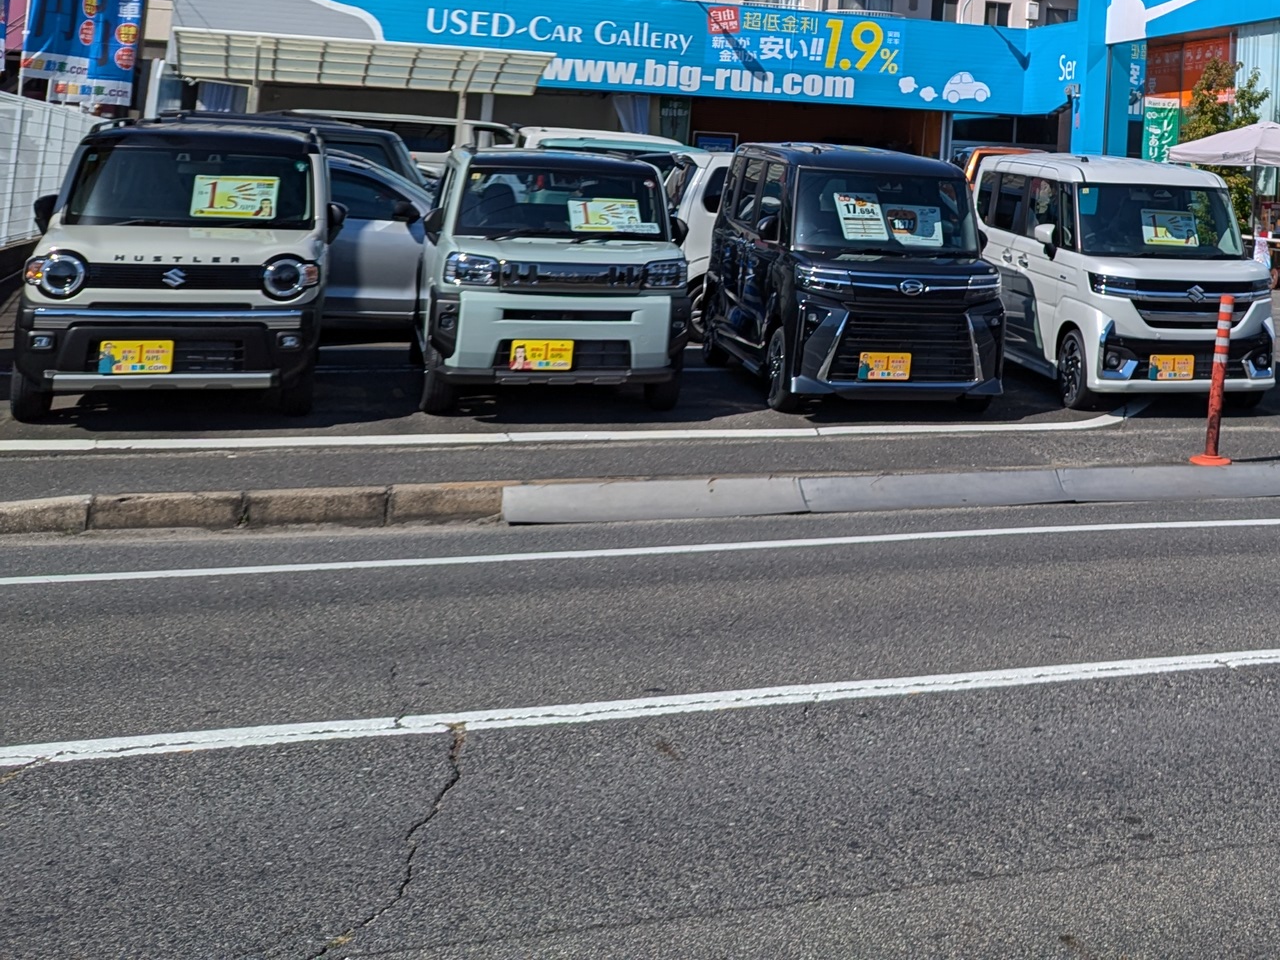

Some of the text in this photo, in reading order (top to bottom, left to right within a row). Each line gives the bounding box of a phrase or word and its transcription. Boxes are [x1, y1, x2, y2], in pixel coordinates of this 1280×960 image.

[743, 12, 819, 35] 超低金利
[825, 19, 900, 75] 1.9%
[544, 56, 855, 99] www.big-run.com
[114, 254, 240, 263] HUSTLER
